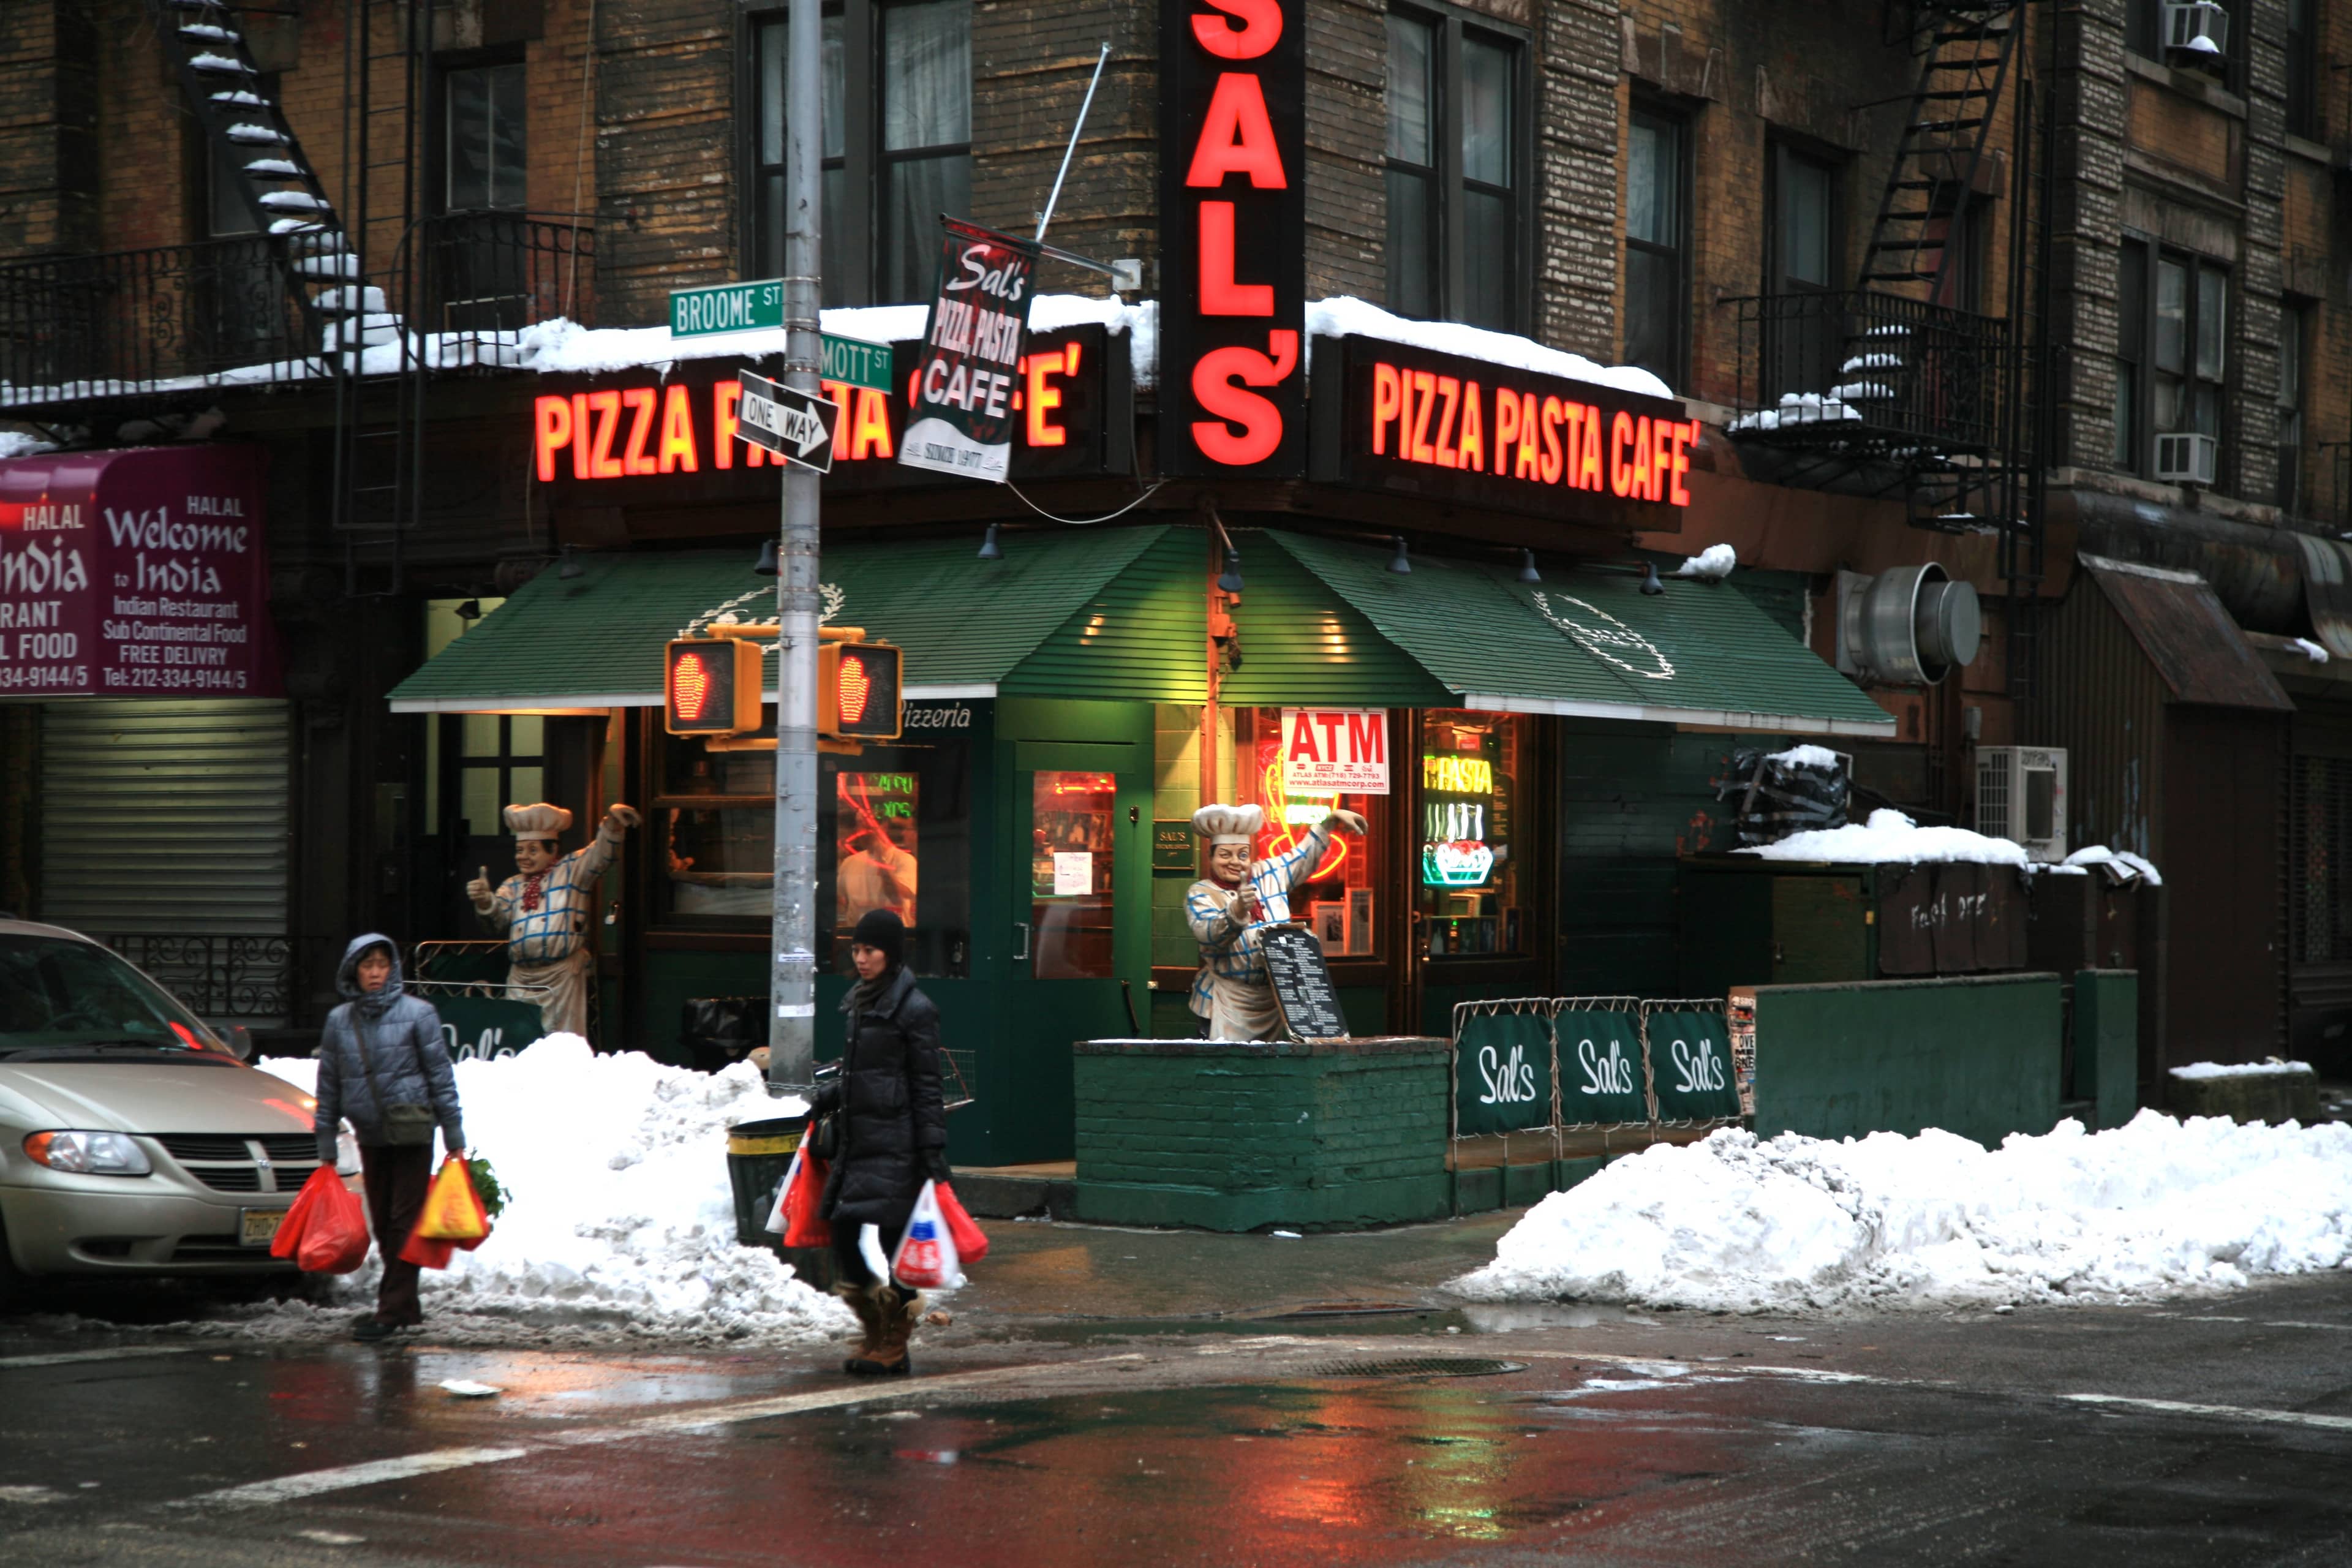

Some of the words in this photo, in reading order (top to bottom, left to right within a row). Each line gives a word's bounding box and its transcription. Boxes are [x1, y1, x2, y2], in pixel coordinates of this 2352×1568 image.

[946, 244, 1024, 301] Sal's
[676, 289, 755, 332] BROOME
[763, 286, 780, 305] ST
[820, 337, 872, 383] MOTT
[874, 350, 889, 369] ST
[972, 308, 1021, 366] PASTA
[924, 358, 1011, 419] CAFE
[535, 383, 698, 481] PIZZA
[714, 378, 893, 469] PTA
[749, 397, 774, 428] ONE
[785, 411, 819, 444] WAY
[1373, 363, 1483, 471] PIZZA
[1494, 387, 1603, 491] PASTA
[23, 505, 85, 530] HALAL
[187, 496, 245, 516] HALAL
[103, 506, 247, 553] Welcome
[0, 535, 88, 594] ndia
[114, 571, 129, 587] to
[135, 552, 222, 594] India
[114, 595, 157, 616] Indian
[159, 597, 239, 619] Restaurant
[18, 633, 77, 660] FOOD
[103, 620, 129, 639] Sub
[132, 620, 211, 642] Continental
[214, 623, 247, 643] Food
[0, 666, 88, 687] 34-9144/5
[103, 668, 129, 686] Tel:
[131, 668, 246, 688] 212-334-9144/5
[119, 645, 160, 663] FREE
[164, 647, 228, 665] DELIVRY
[1289, 712, 1384, 763] ATM
[1289, 779, 1384, 789] www.atlasatmcorp.com
[1438, 757, 1492, 794] PASTA
[1479, 1044, 1536, 1104] Sal's
[1578, 1039, 1633, 1095] Sal's
[1671, 1039, 1725, 1092] Sal's
